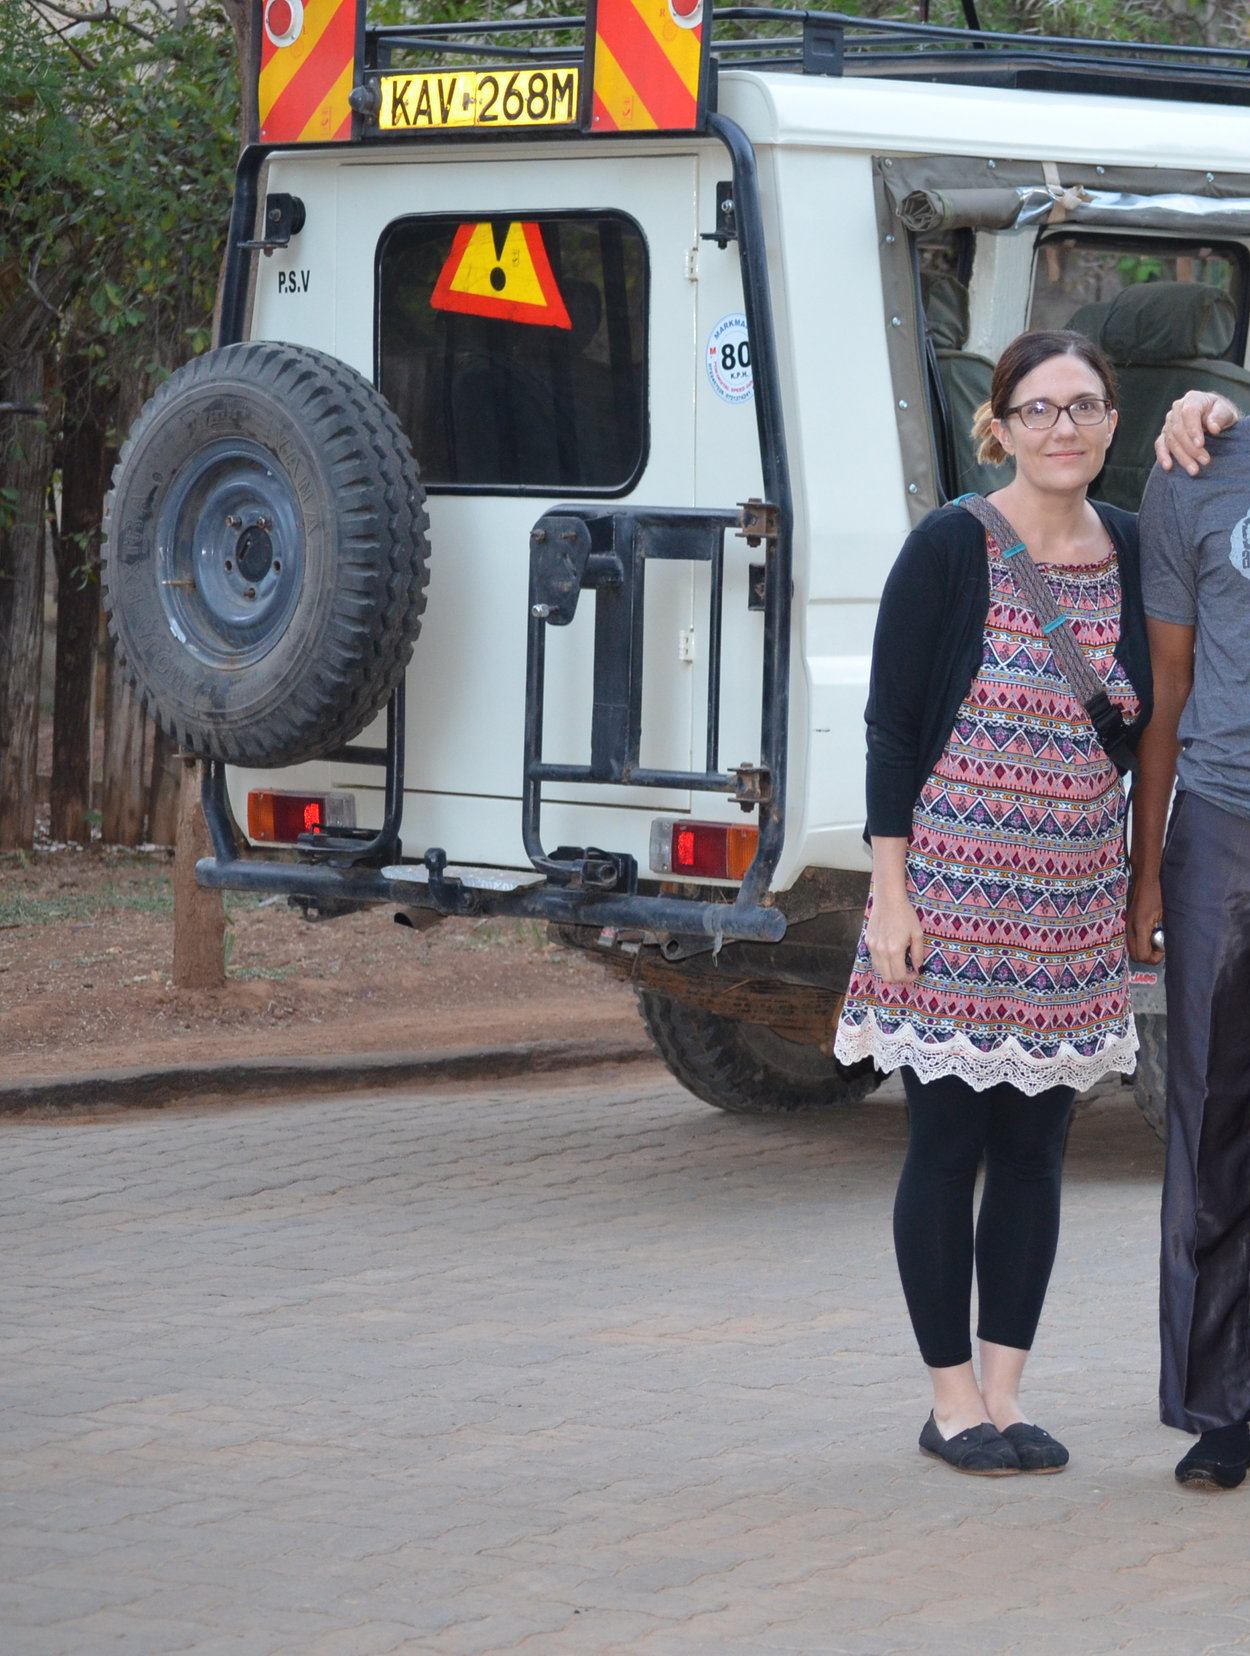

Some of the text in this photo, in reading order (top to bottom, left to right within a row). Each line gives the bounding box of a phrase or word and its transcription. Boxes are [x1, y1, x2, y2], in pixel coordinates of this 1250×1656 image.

[391, 79, 457, 126] KAV
[477, 72, 574, 122] 268M
[278, 269, 311, 294] P.S.V
[714, 319, 749, 340] MARKMA
[721, 341, 752, 371] 80
